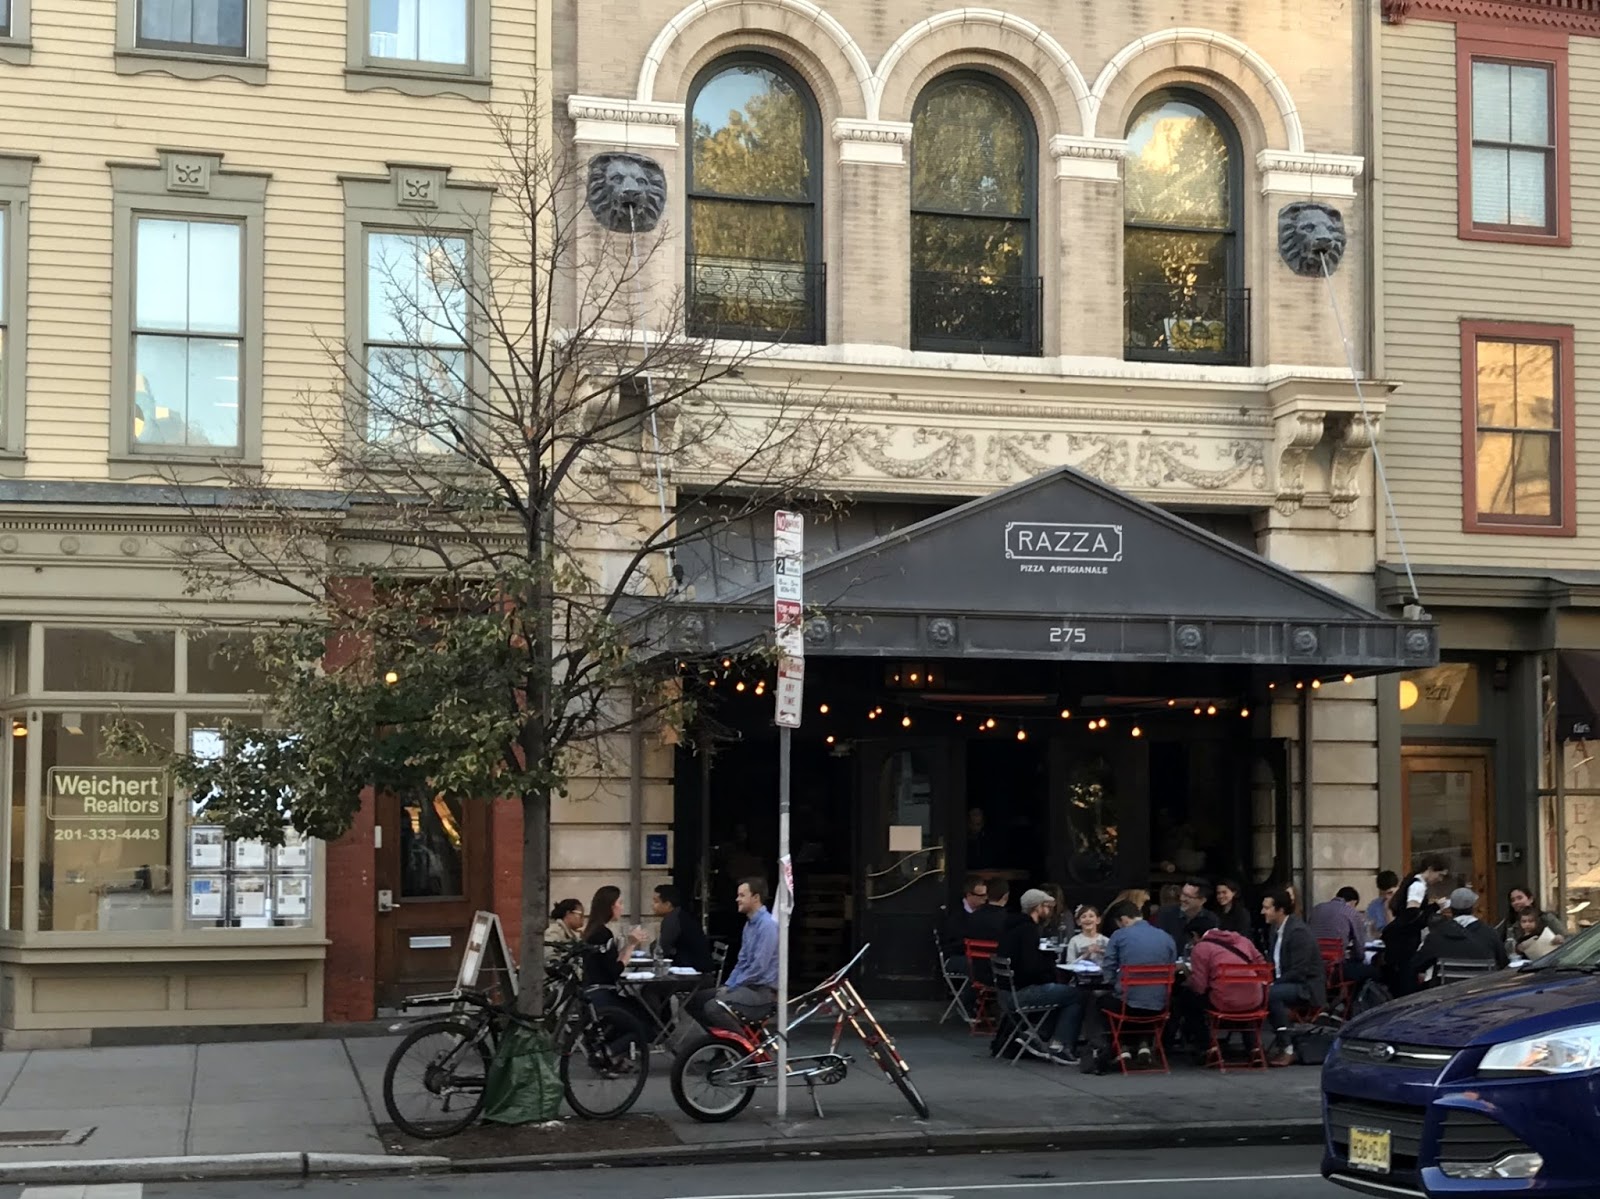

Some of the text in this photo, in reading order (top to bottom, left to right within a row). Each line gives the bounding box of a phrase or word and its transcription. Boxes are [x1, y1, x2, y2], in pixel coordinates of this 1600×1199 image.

[777, 514, 785, 531] NO
[1018, 530, 1108, 553] RAZZA
[777, 558, 783, 573] 2
[1020, 564, 1108, 575] PIZZA ARTIGIANALE
[1049, 627, 1086, 643] 275
[785, 683, 794, 693] ANY
[783, 696, 795, 707] TIME
[84, 796, 160, 814] Realtors
[54, 828, 161, 841] 201-333-4443
